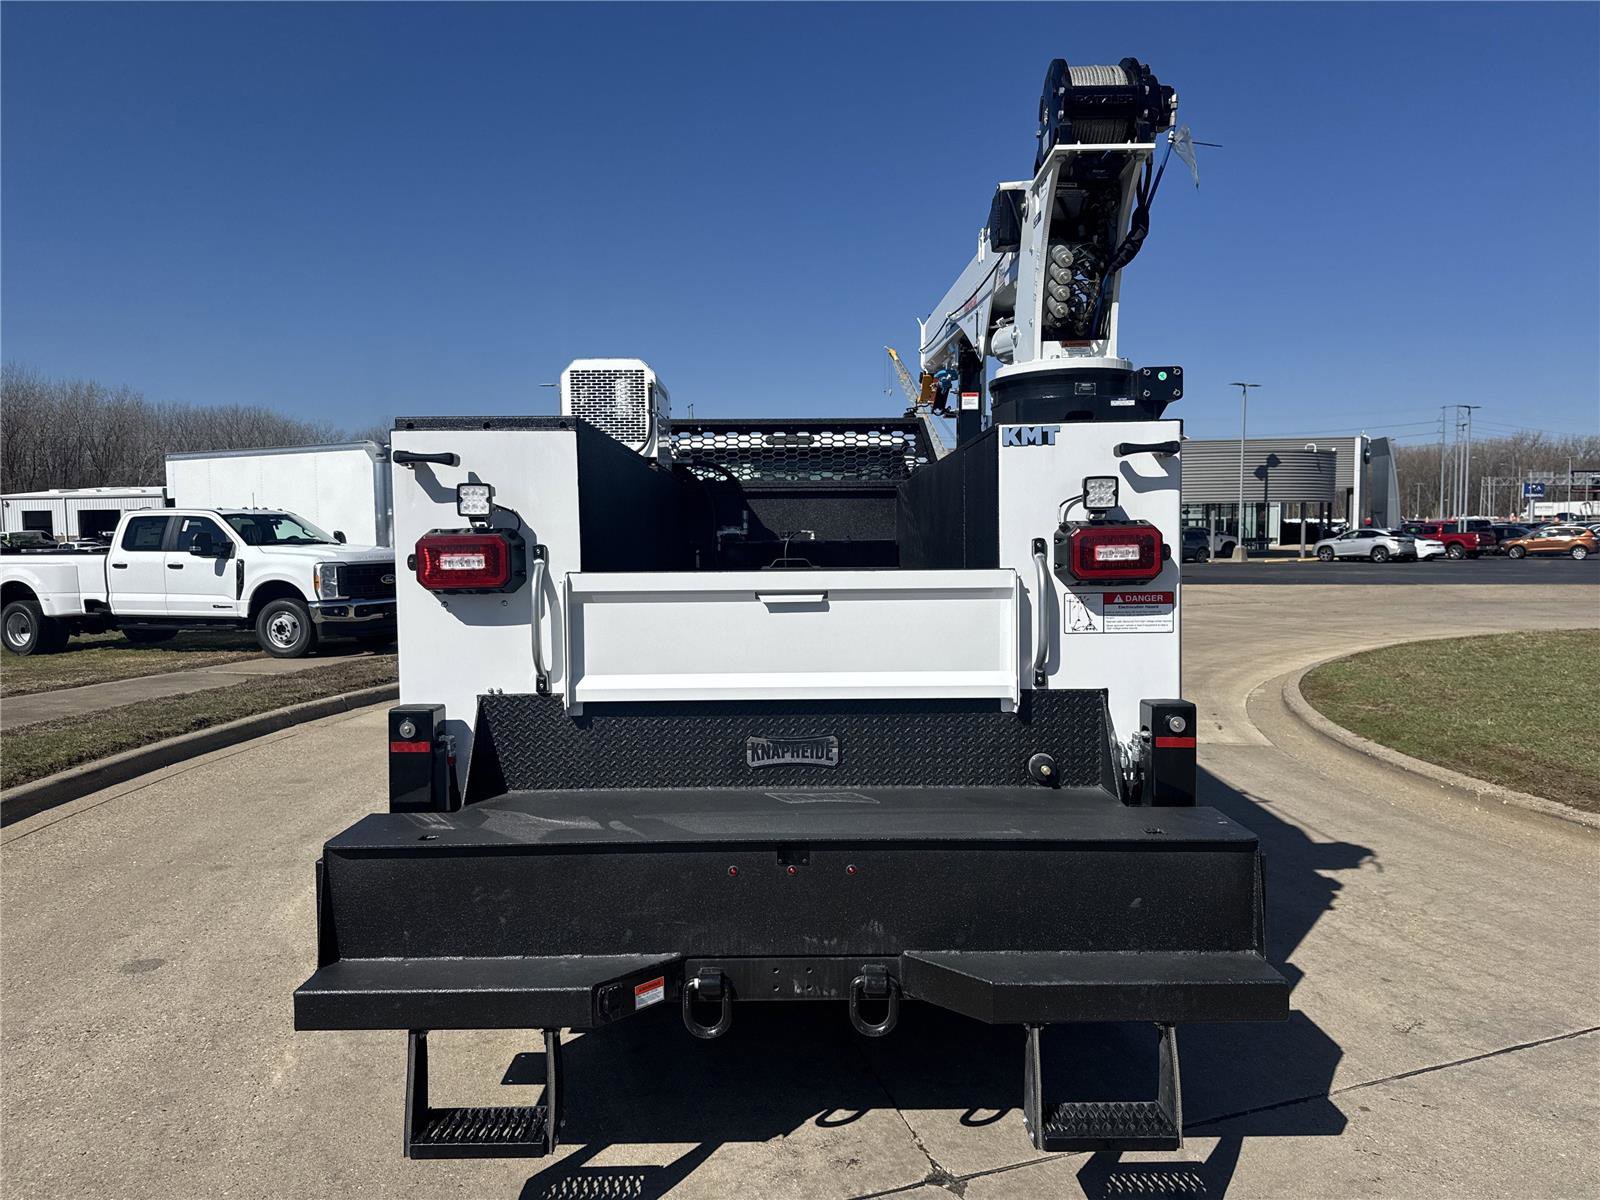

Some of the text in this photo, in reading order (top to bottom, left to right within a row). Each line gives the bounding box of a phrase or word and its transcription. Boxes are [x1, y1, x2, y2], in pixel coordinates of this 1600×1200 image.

[1002, 425, 1060, 447] KMT
[1125, 594, 1164, 602] DANGER
[751, 739, 834, 763] KNAPHEIDE
